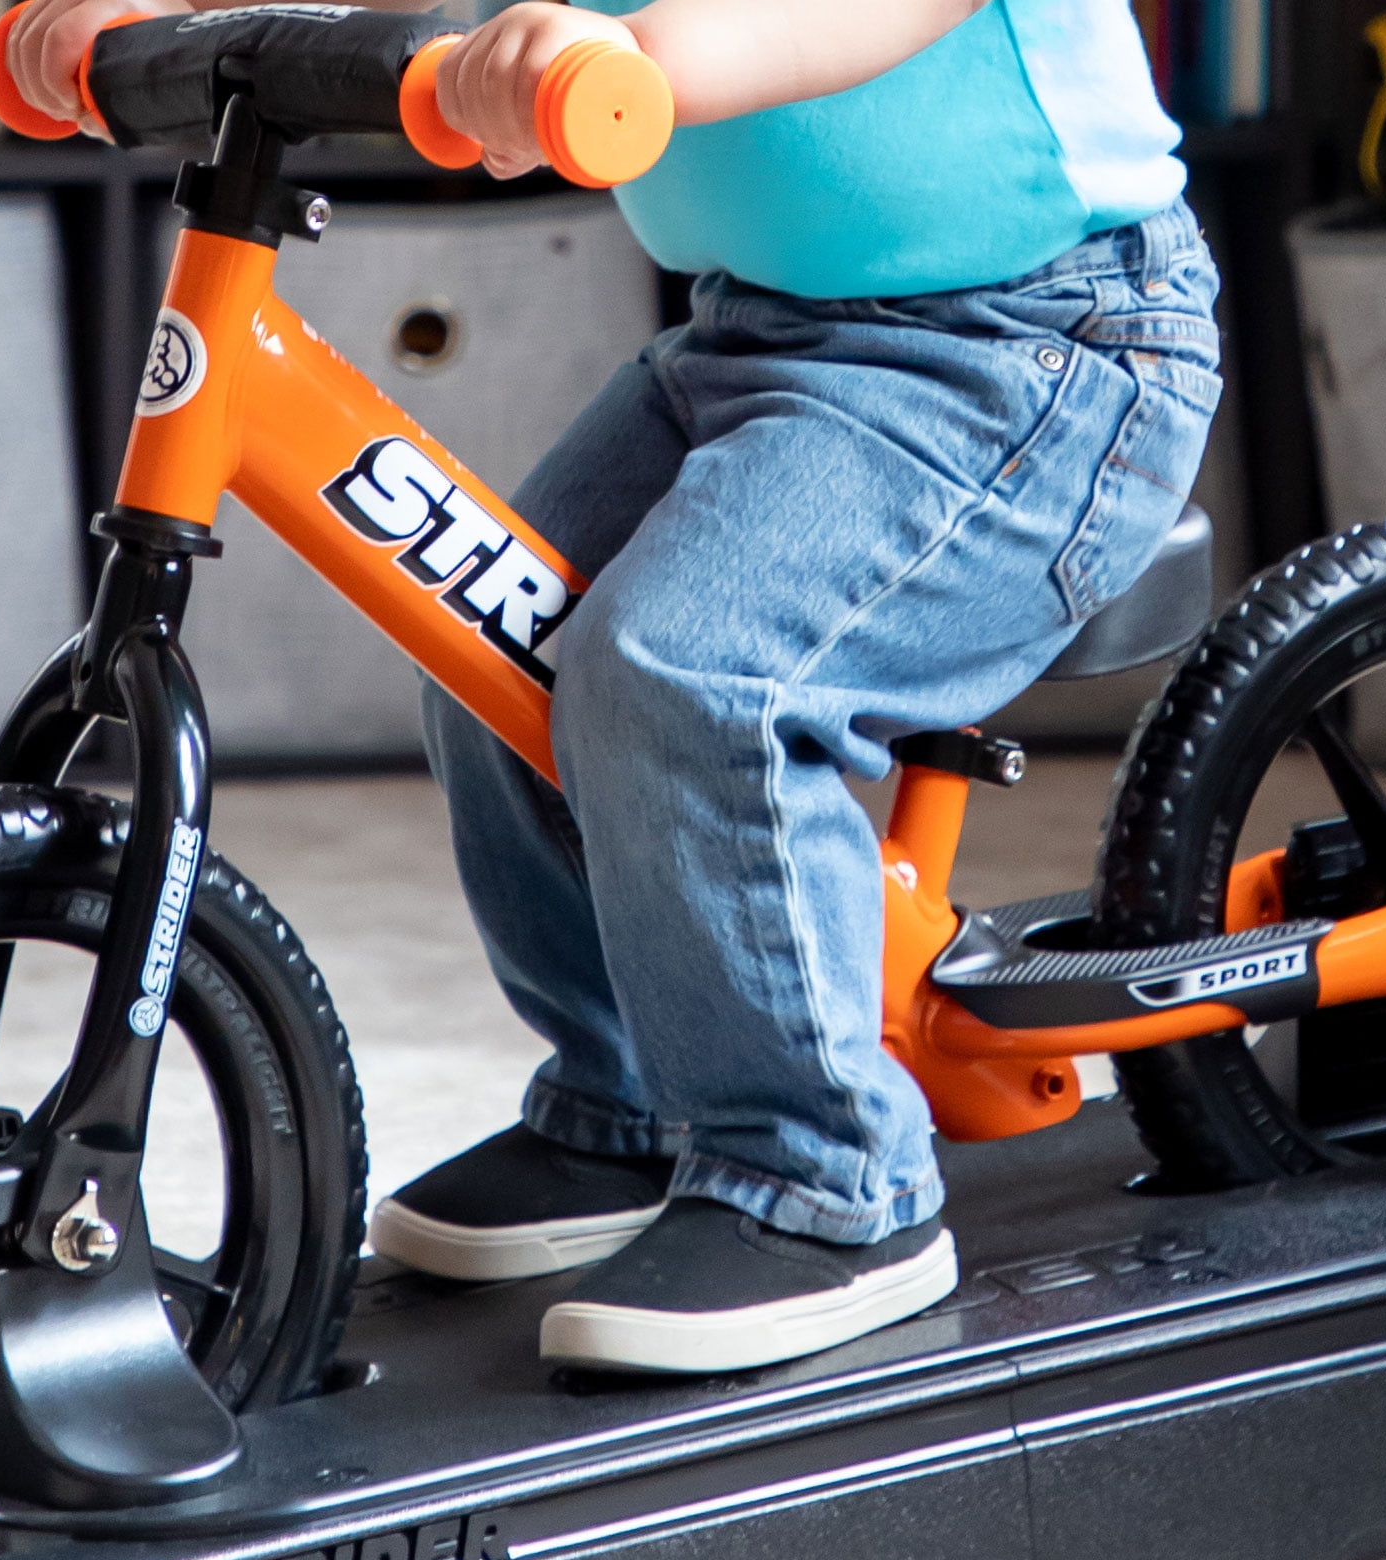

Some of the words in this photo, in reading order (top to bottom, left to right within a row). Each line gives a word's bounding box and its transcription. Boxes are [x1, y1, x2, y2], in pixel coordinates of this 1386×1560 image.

[318, 434, 571, 670] STR
[143, 825, 201, 998] STRIDER
[1199, 953, 1299, 990] SPORT
